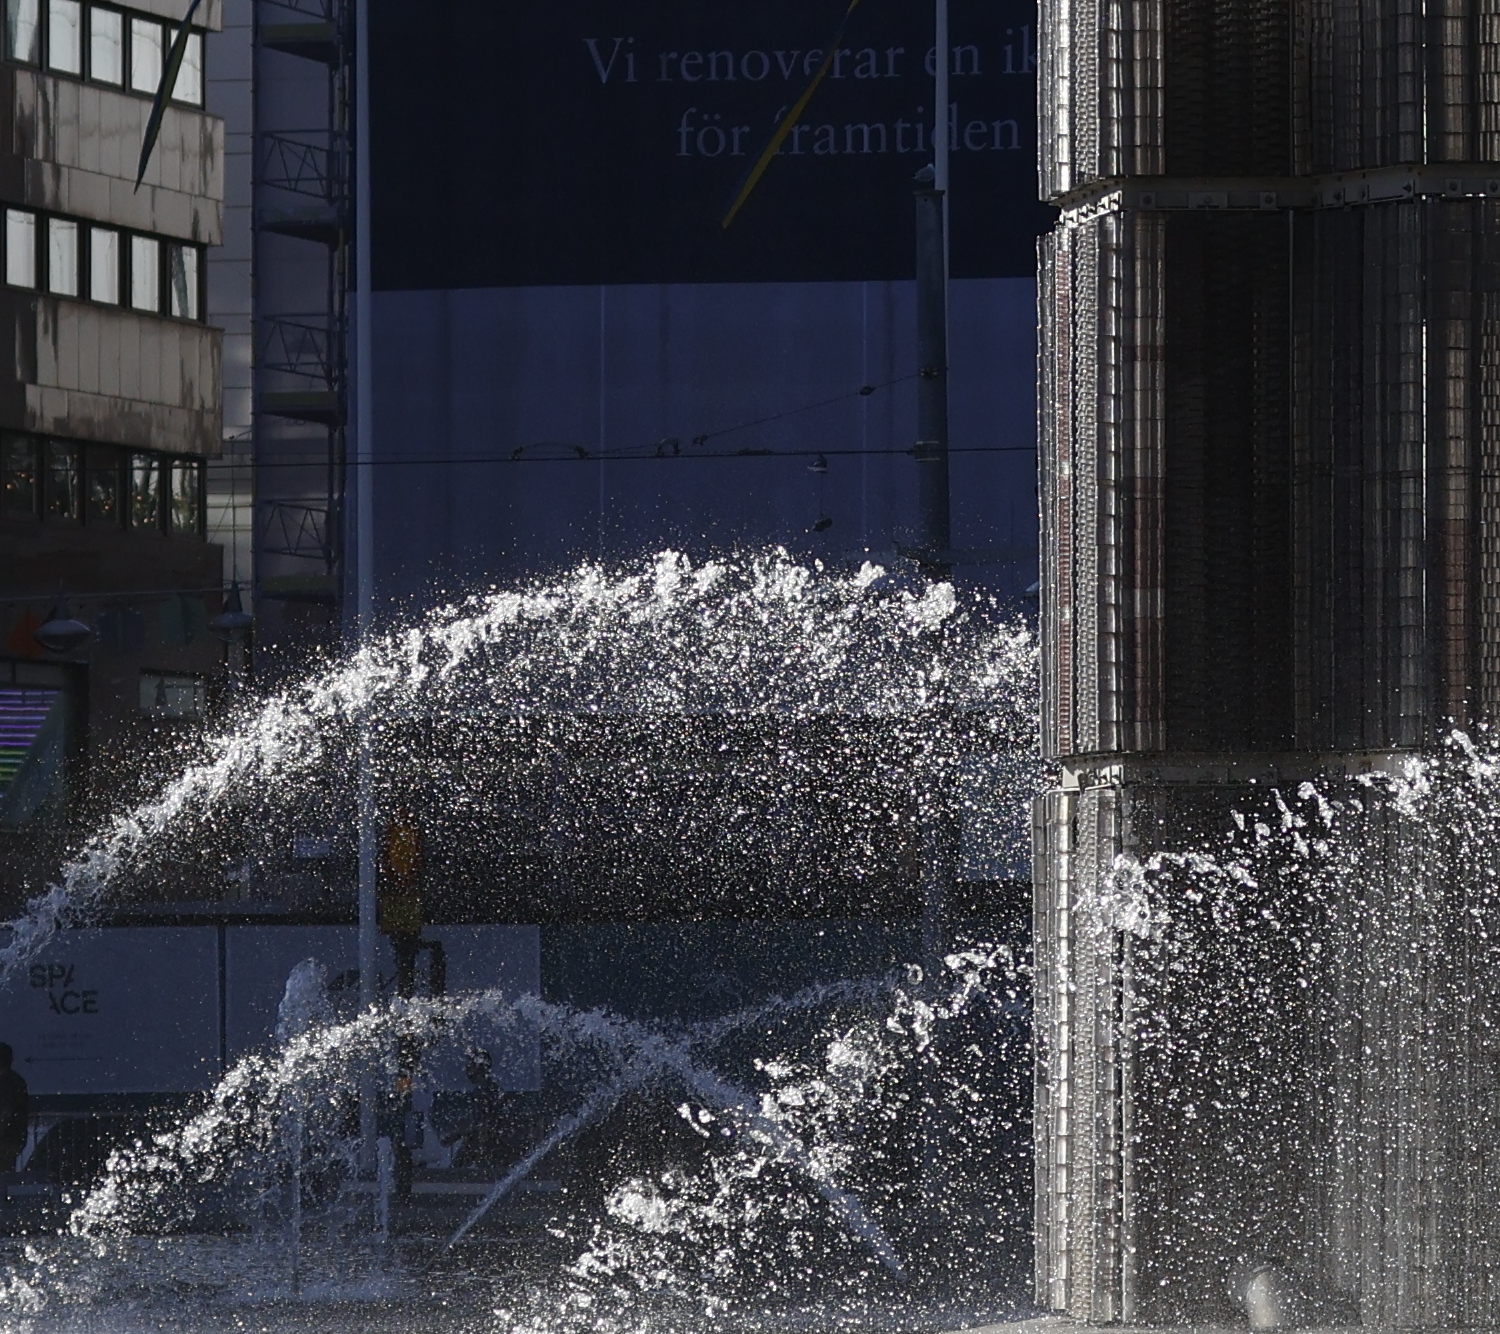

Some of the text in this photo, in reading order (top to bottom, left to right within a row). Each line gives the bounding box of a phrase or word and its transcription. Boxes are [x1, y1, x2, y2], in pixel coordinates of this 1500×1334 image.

[582, 36, 637, 83] Vi
[656, 45, 905, 83] renoverar
[675, 106, 751, 157] för
